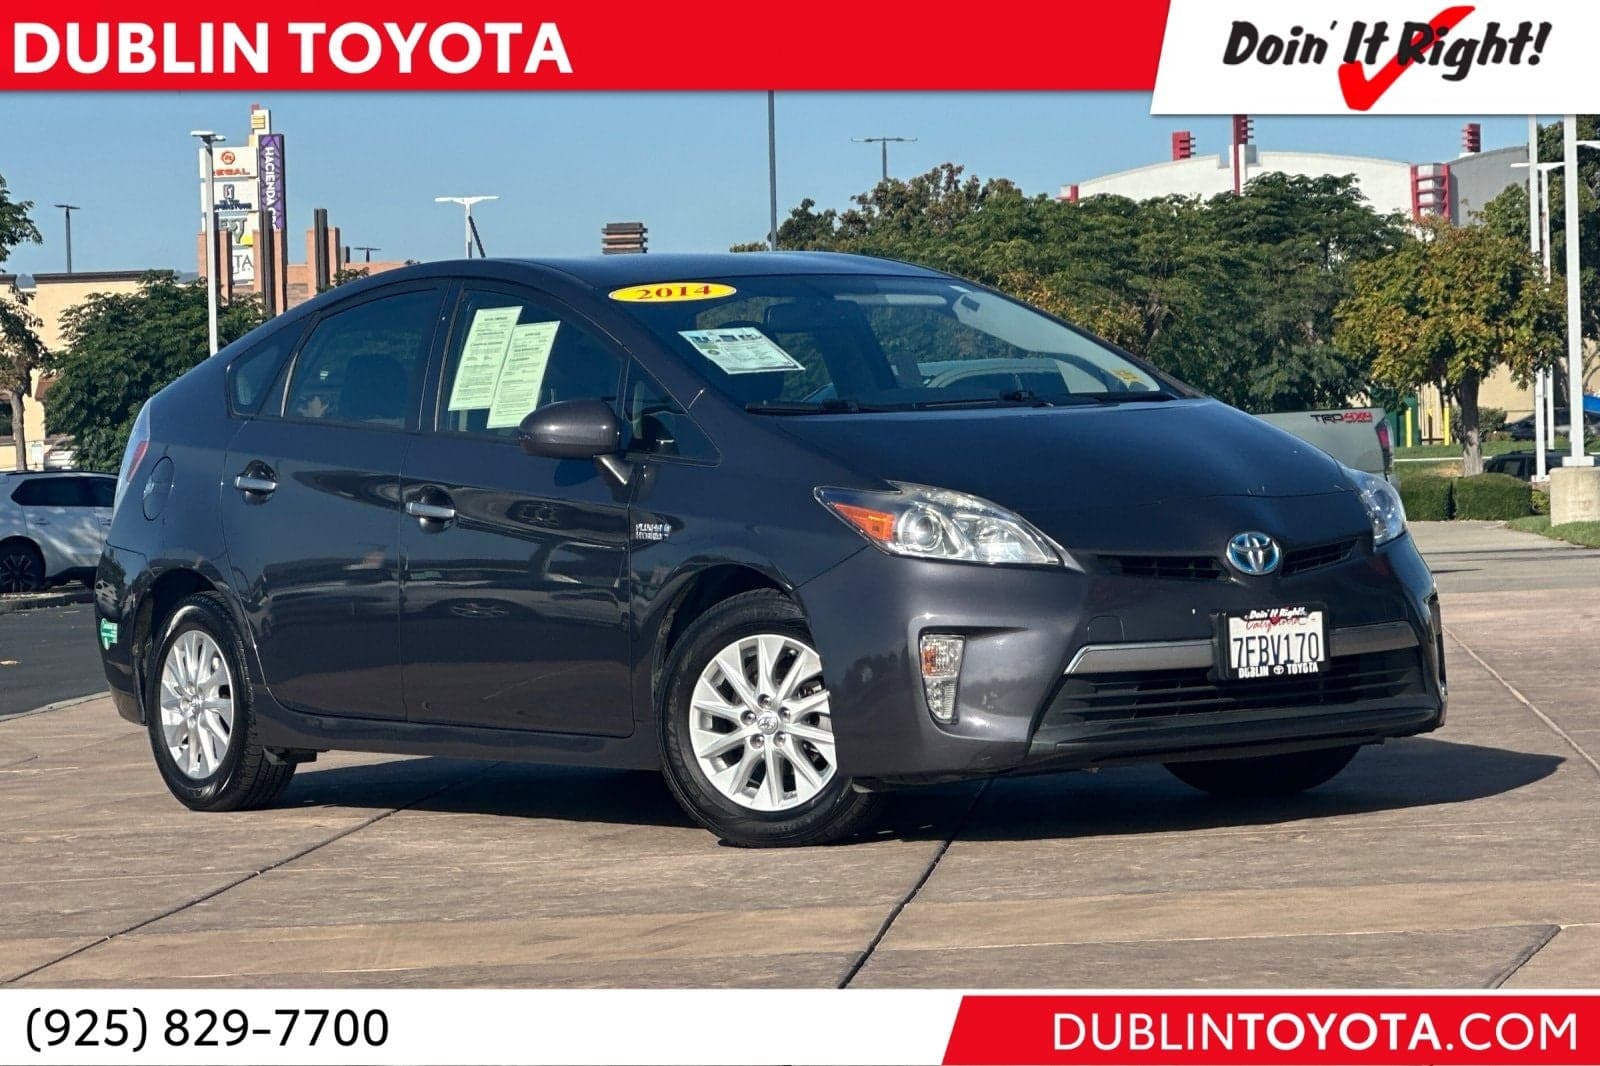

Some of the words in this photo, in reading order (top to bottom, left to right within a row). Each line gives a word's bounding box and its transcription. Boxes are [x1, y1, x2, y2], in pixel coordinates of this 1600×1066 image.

[213, 167, 251, 176] EGAL
[264, 146, 276, 206] HACIENDA
[635, 284, 711, 300] 2014
[1232, 631, 1320, 668] 7FBV170
[1238, 665, 1270, 679] DUBLIN
[1286, 661, 1319, 675] TOYOTA
